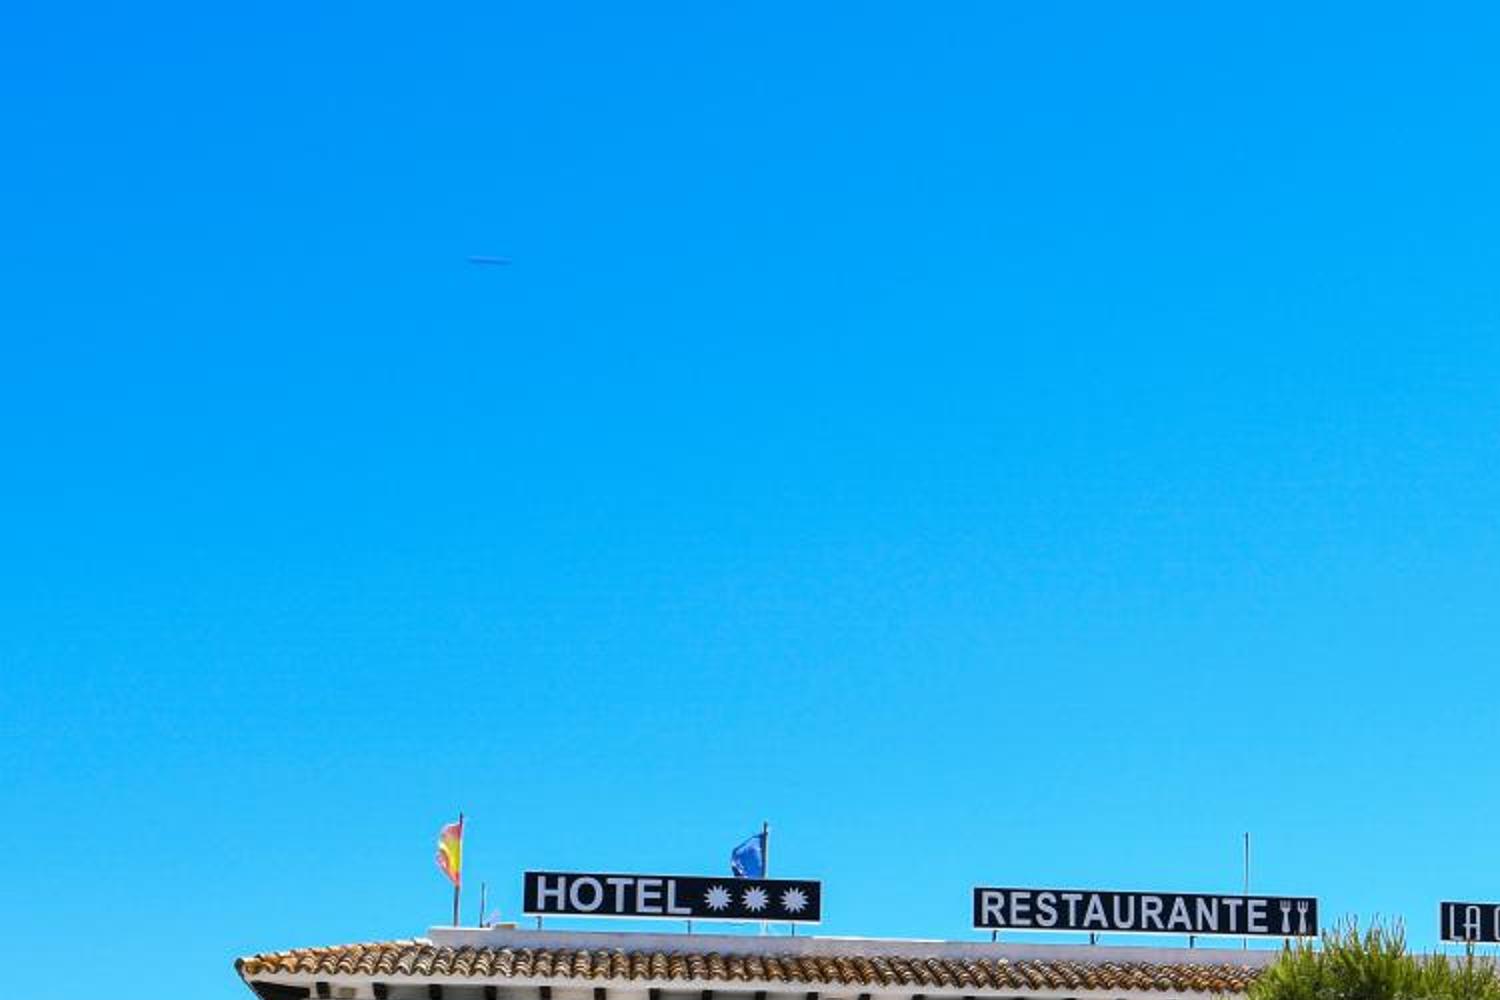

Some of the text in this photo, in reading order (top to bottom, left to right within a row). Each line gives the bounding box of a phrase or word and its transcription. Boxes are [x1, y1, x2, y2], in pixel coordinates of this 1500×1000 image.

[536, 875, 692, 915] HOTEL
[981, 891, 1268, 932] RESTAURANTE
[1450, 904, 1481, 941] LA
